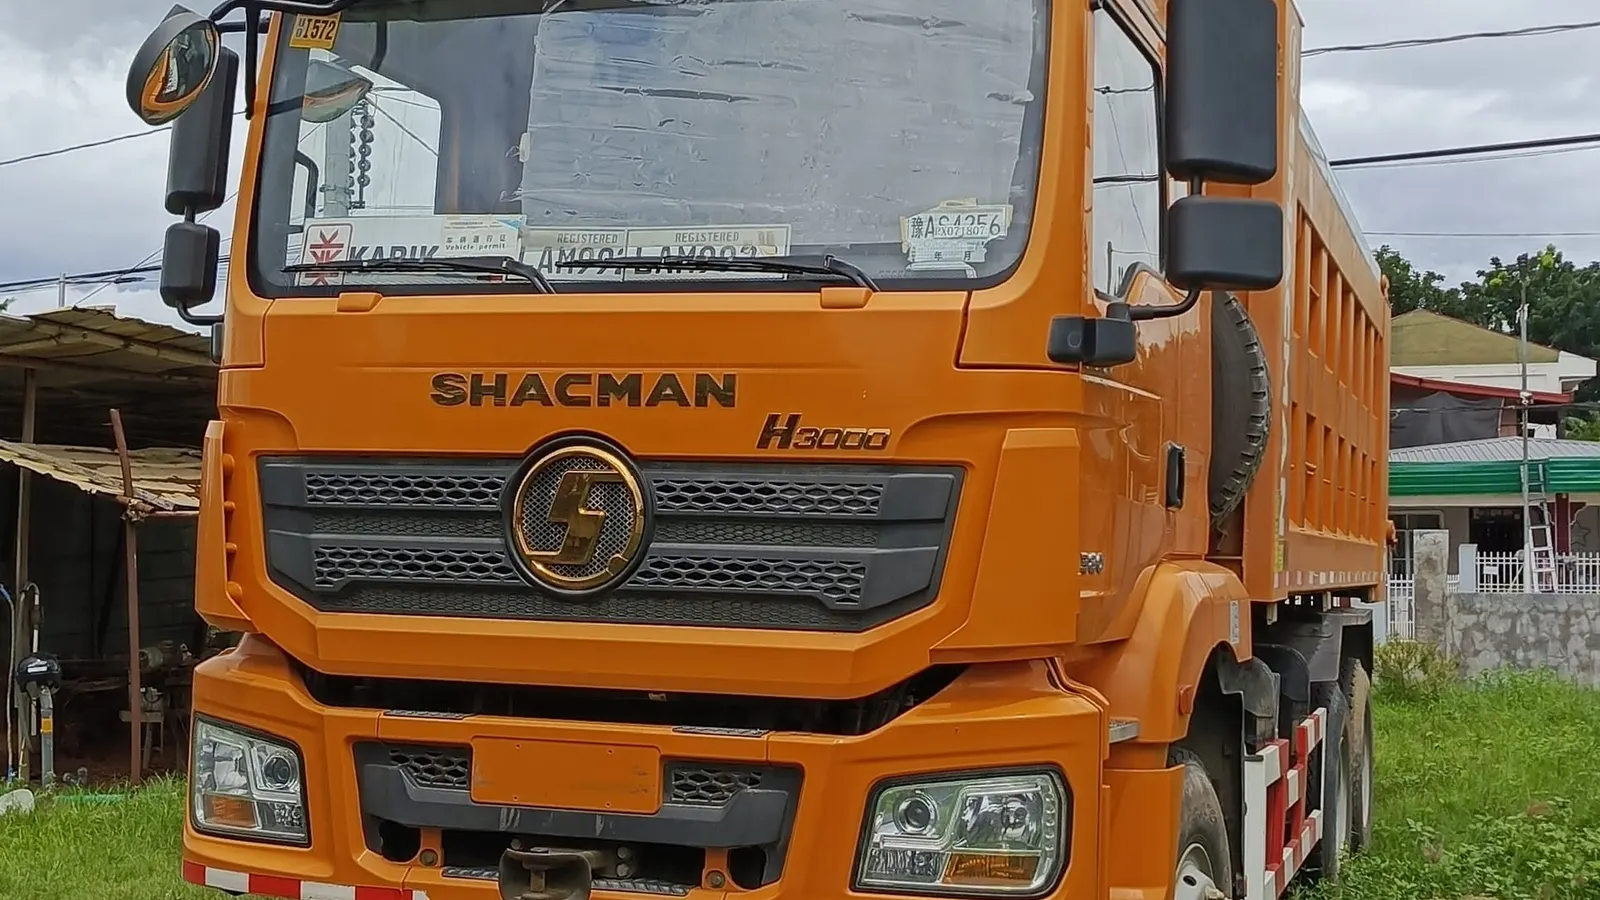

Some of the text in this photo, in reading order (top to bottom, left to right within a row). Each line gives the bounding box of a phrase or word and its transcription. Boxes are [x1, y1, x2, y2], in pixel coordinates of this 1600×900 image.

[557, 233, 618, 244] REGISTERED
[675, 231, 740, 244] REGISTERED
[430, 372, 737, 408] SHACMAN
[756, 411, 892, 450] H3000
